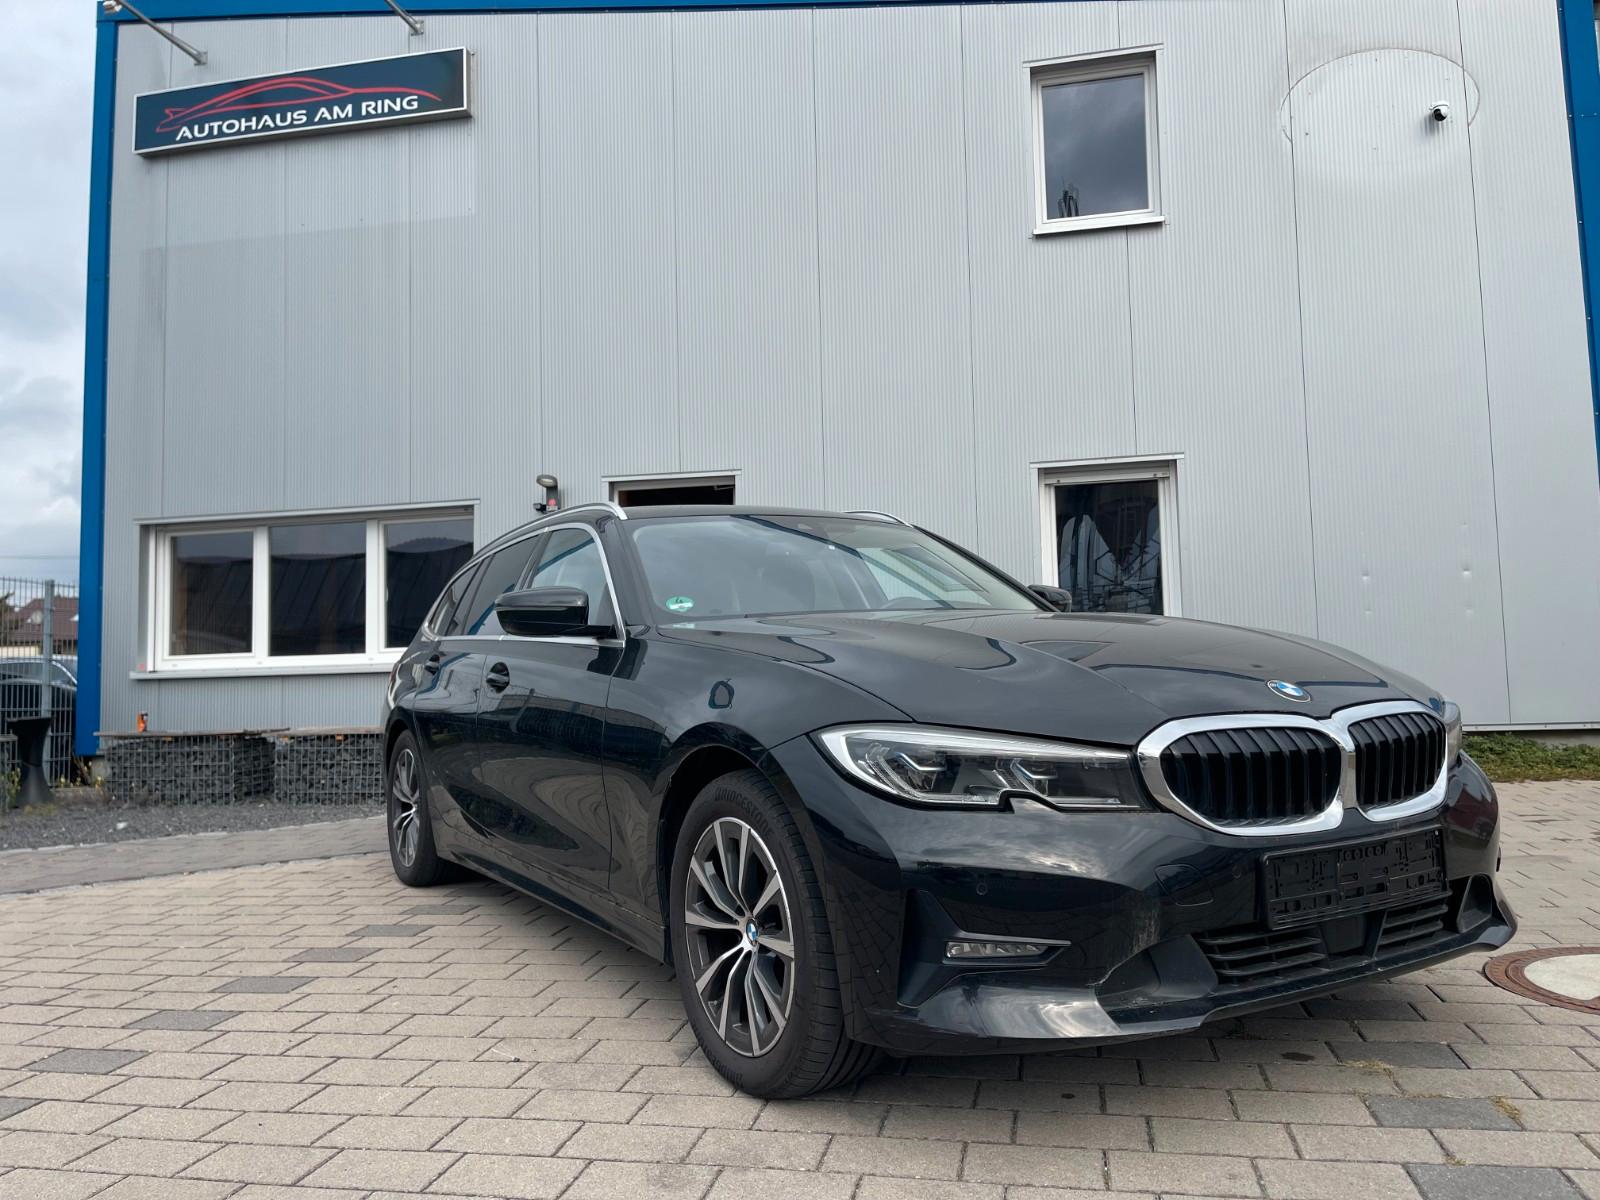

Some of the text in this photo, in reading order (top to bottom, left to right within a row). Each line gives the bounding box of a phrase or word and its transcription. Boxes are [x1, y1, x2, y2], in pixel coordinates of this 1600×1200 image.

[176, 95, 418, 141] AUTOHAUS AM RING
